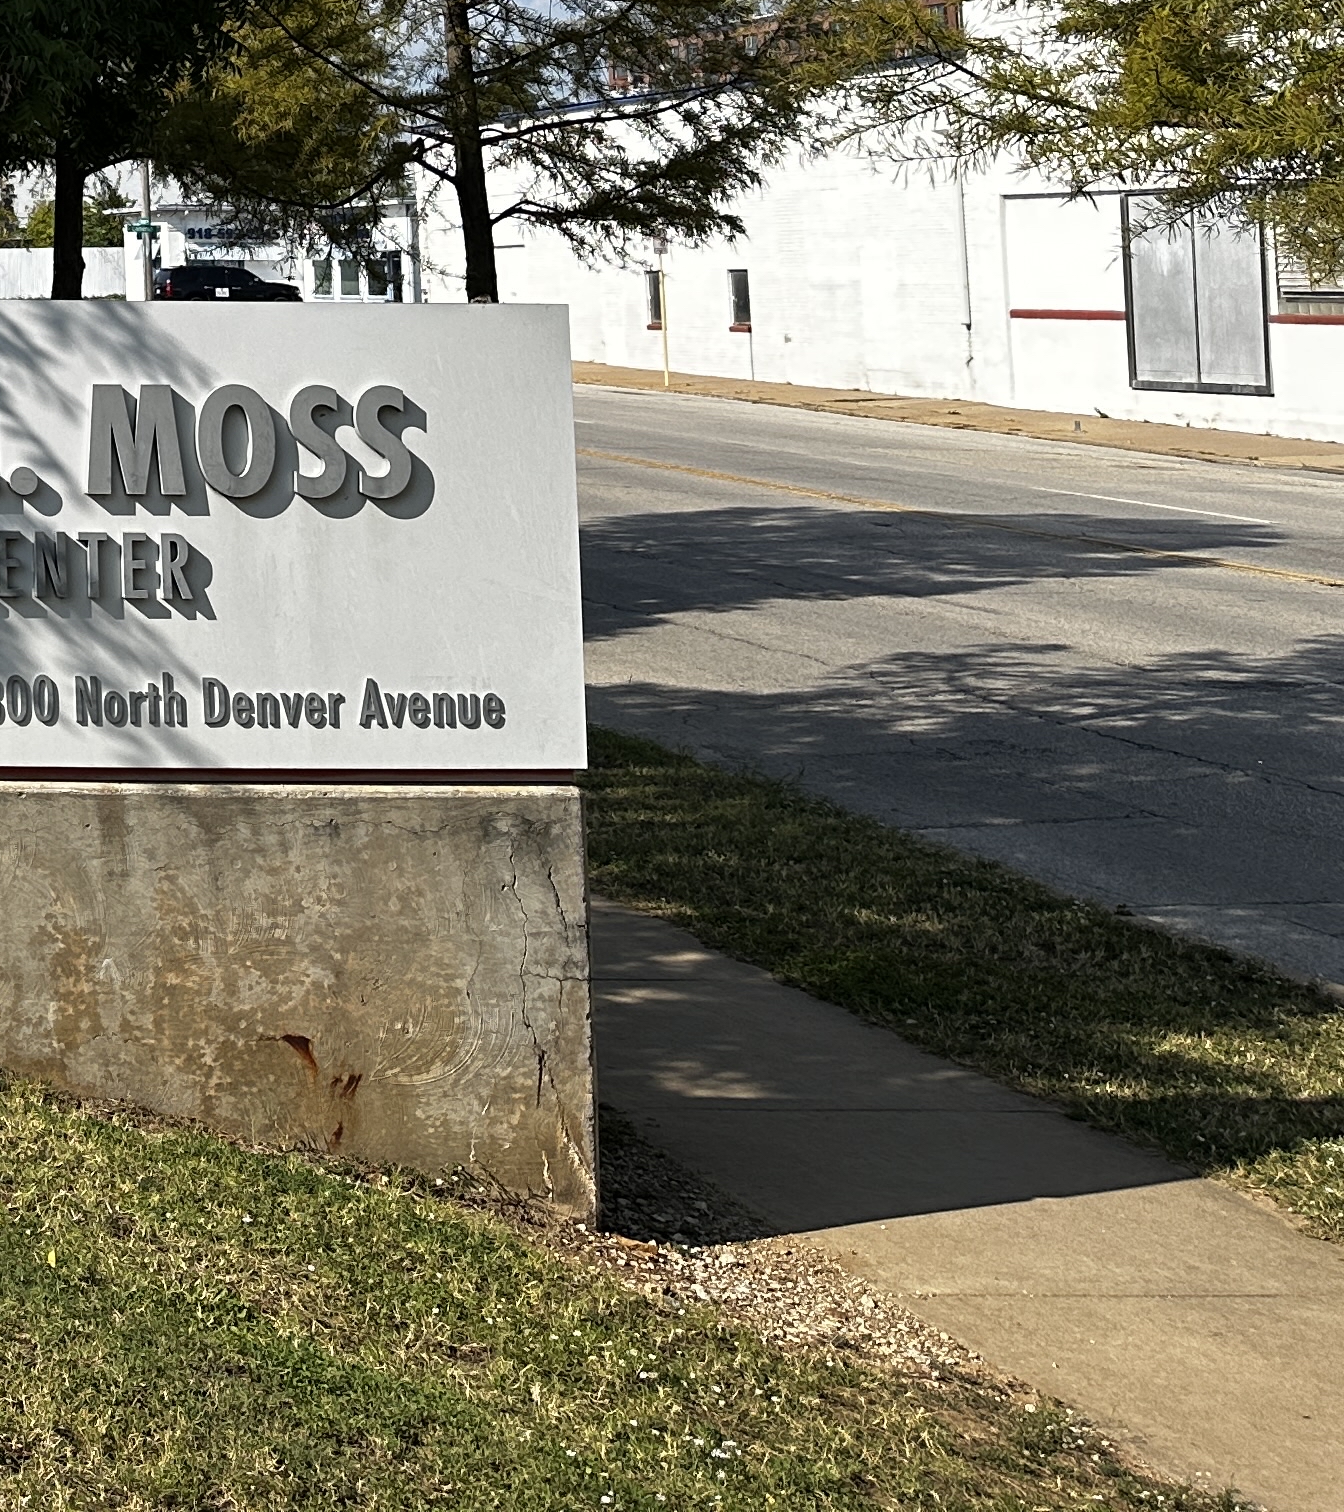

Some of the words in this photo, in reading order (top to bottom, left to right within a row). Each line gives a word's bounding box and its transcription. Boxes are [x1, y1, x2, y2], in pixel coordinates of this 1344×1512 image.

[86, 383, 412, 499] MOSS
[73, 672, 188, 728] North
[202, 677, 345, 730] Denver
[358, 677, 506, 730] Avenue
